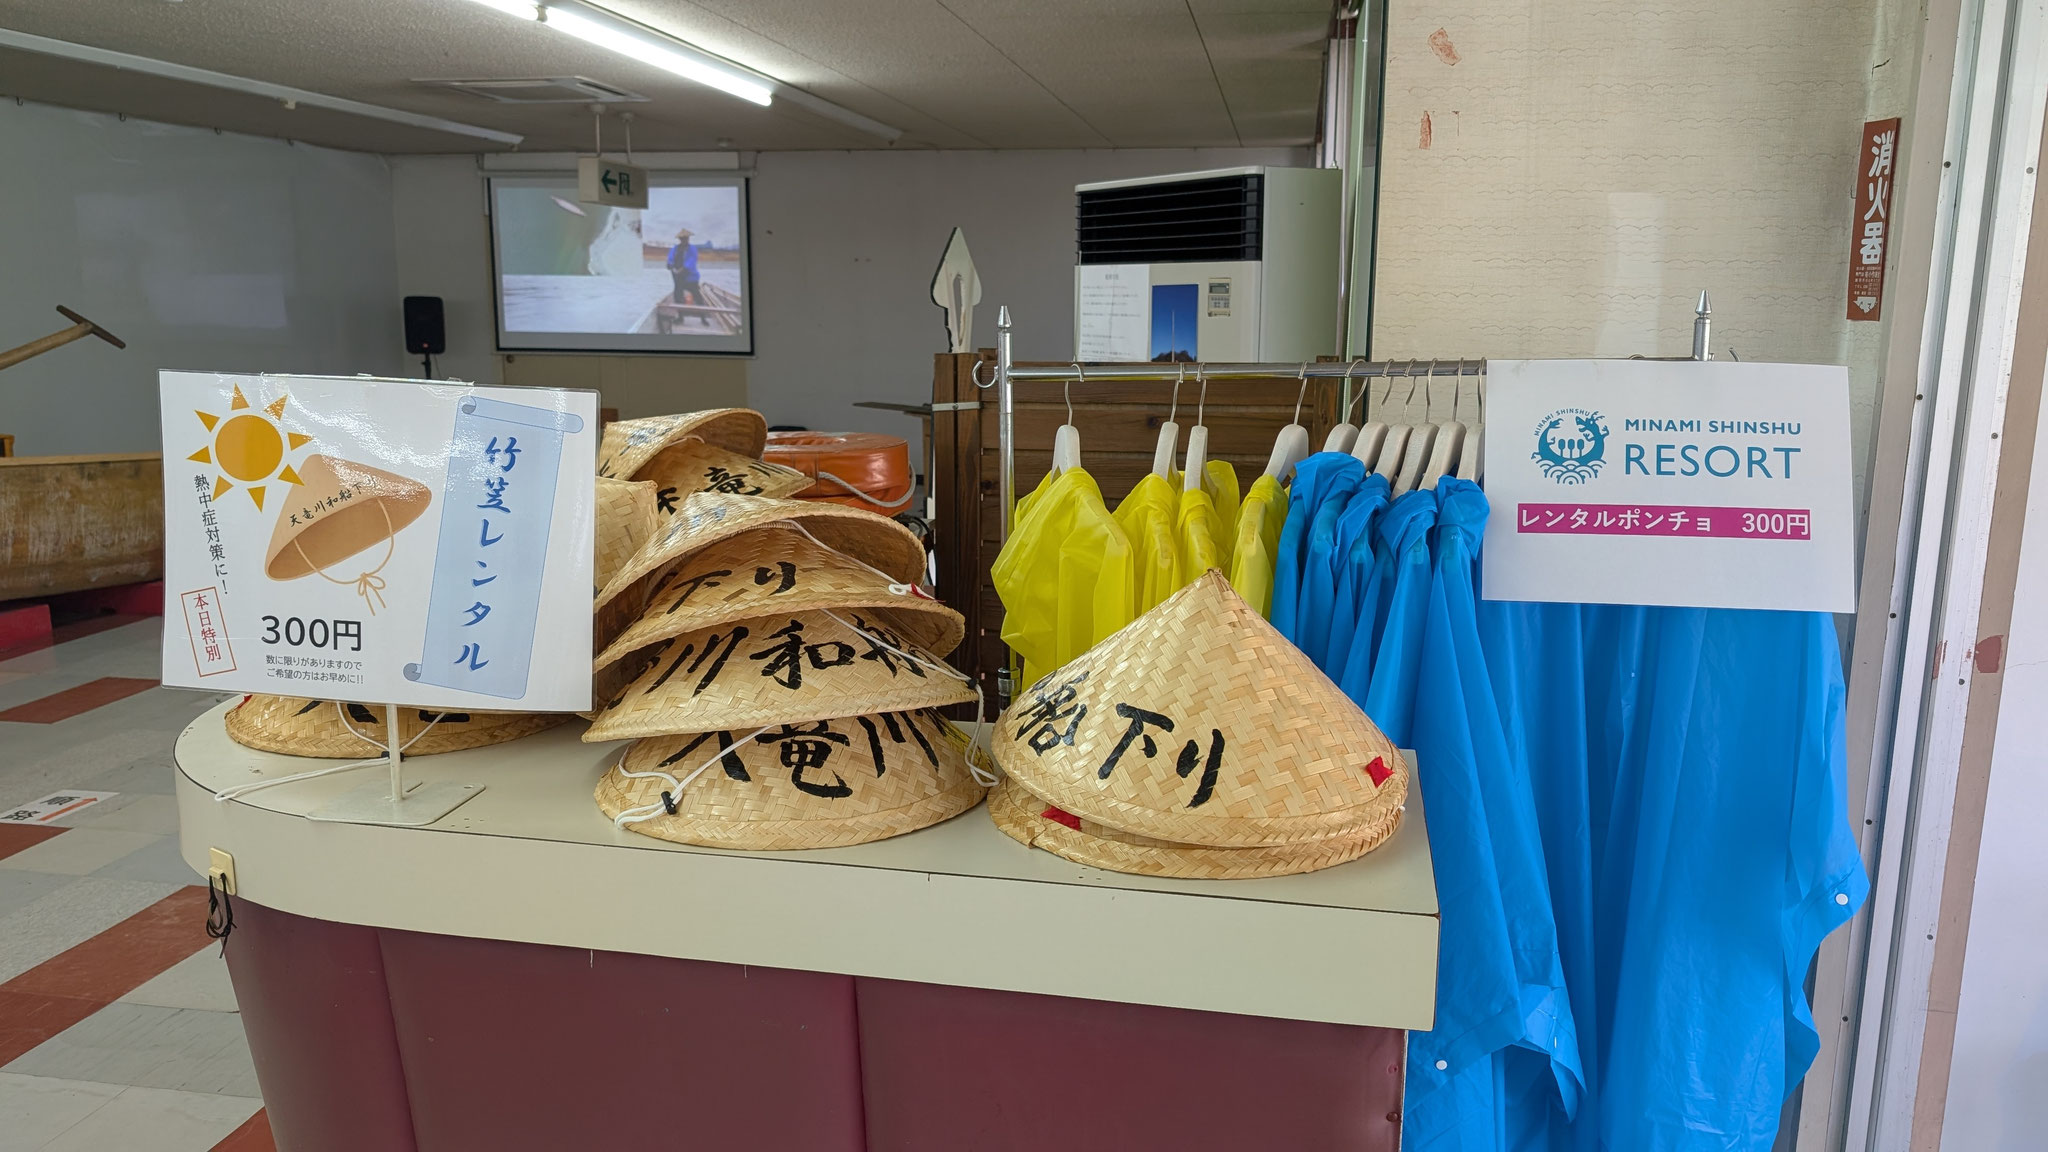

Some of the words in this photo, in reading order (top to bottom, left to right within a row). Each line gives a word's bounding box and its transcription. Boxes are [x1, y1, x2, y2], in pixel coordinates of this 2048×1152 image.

[1860, 130, 1895, 265] 消火器
[1534, 413, 1554, 436] MINAMI
[1556, 408, 1590, 417] SHINSHU
[1625, 418, 1701, 433] MINAMI
[1709, 420, 1801, 436] SHINSHU
[1625, 444, 1801, 480] RESORT
[1521, 508, 1711, 533] レンタルポンチョ
[1742, 513, 1809, 536] 300円
[454, 436, 522, 671] 竹笠レンタル
[193, 593, 222, 663] 本日特別
[261, 615, 362, 652] 300円
[266, 655, 363, 671] 数に限りがありますので
